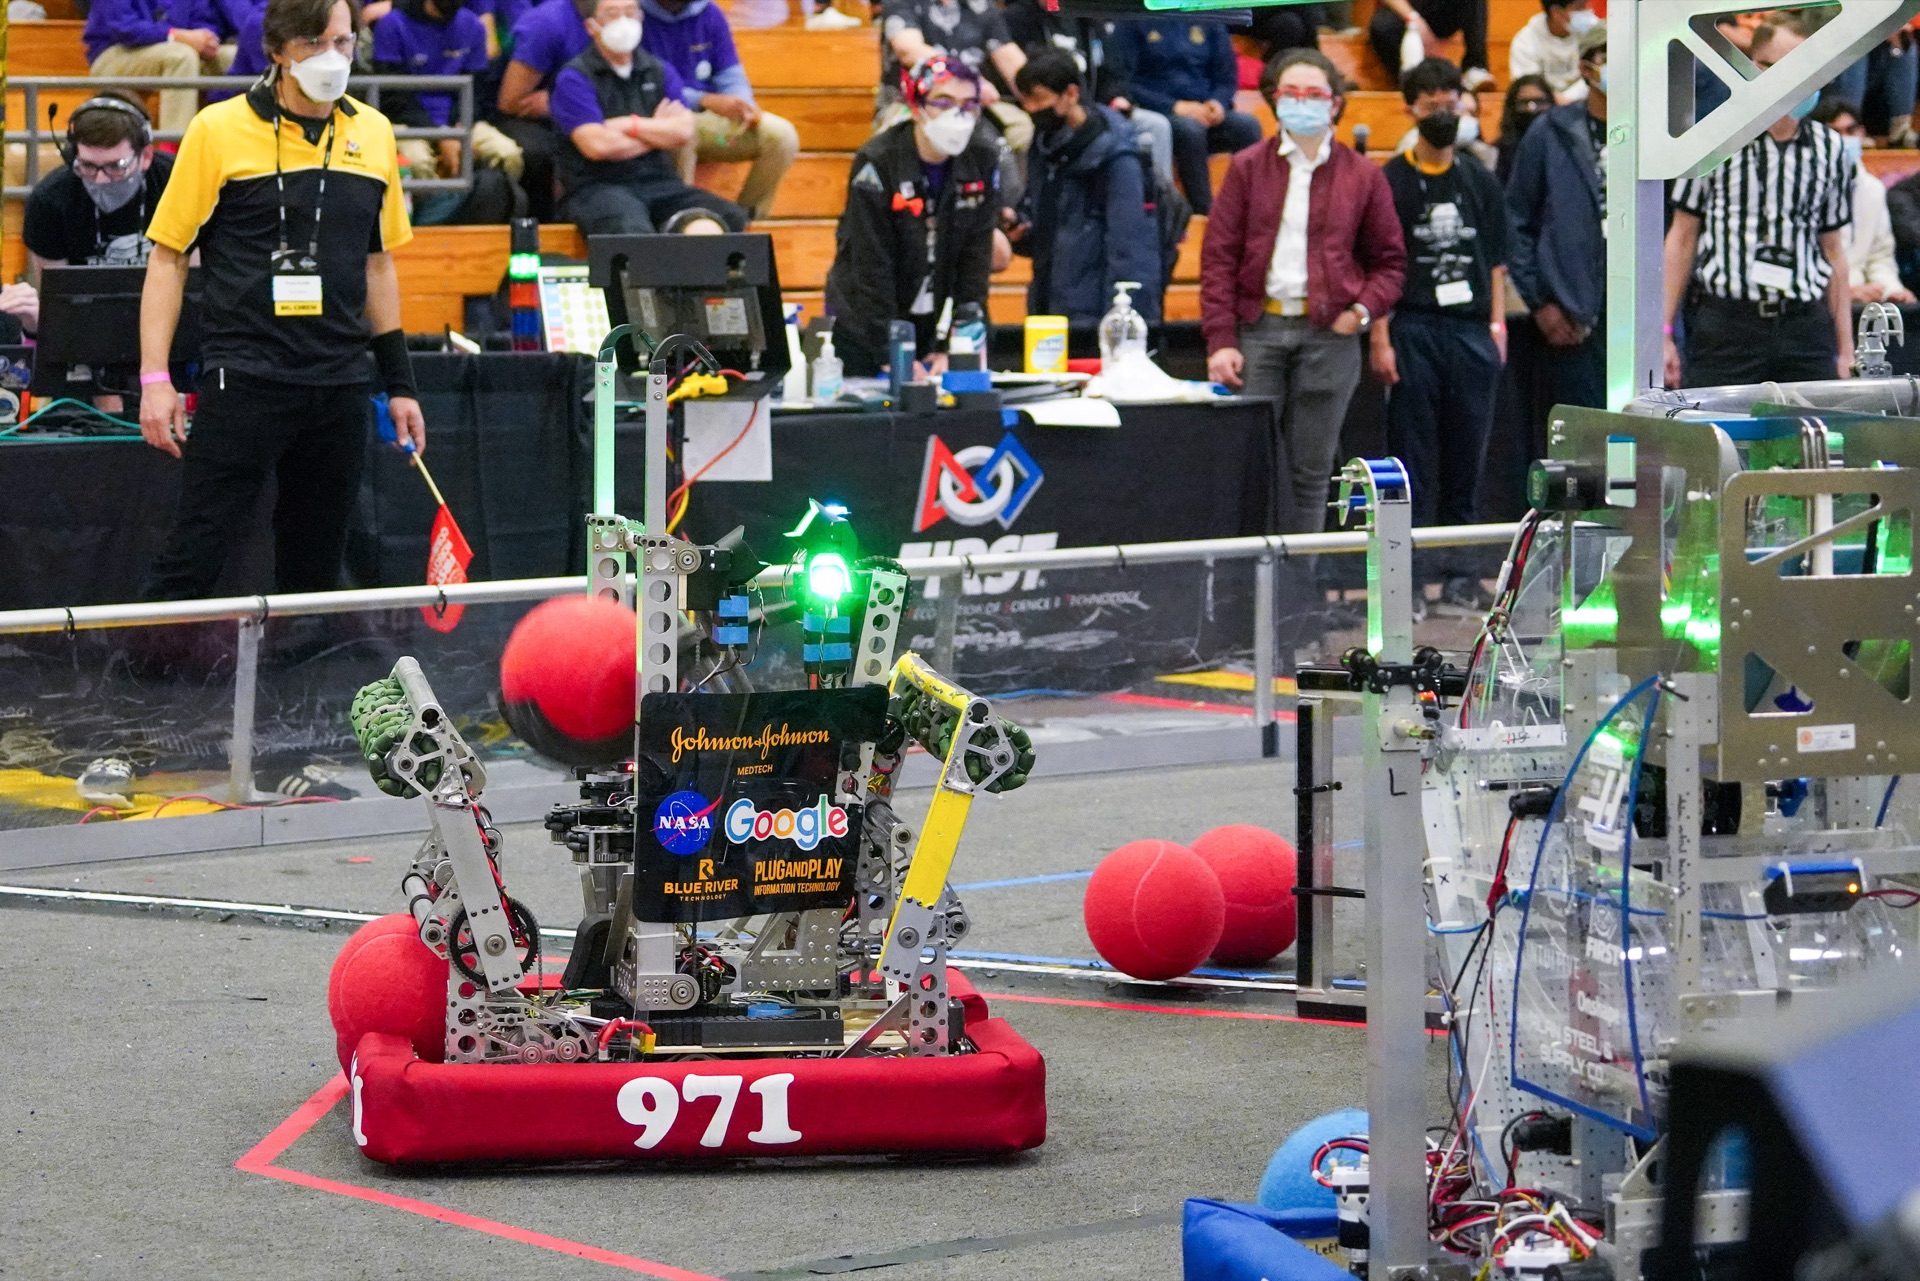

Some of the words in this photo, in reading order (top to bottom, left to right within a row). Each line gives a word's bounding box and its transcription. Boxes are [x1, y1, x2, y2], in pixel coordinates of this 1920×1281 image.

[737, 764, 773, 775] MEDTECH
[659, 815, 711, 830] NASA
[725, 794, 849, 850] Google
[664, 882, 703, 894] BLUE
[704, 878, 739, 894] RIVER
[754, 883, 796, 896] INFORMATION
[797, 881, 841, 894] TECHNOLOGY
[679, 893, 727, 902] TECHNOLOGY
[1563, 1026, 1602, 1057] STEEL
[616, 1072, 803, 1150] 971
